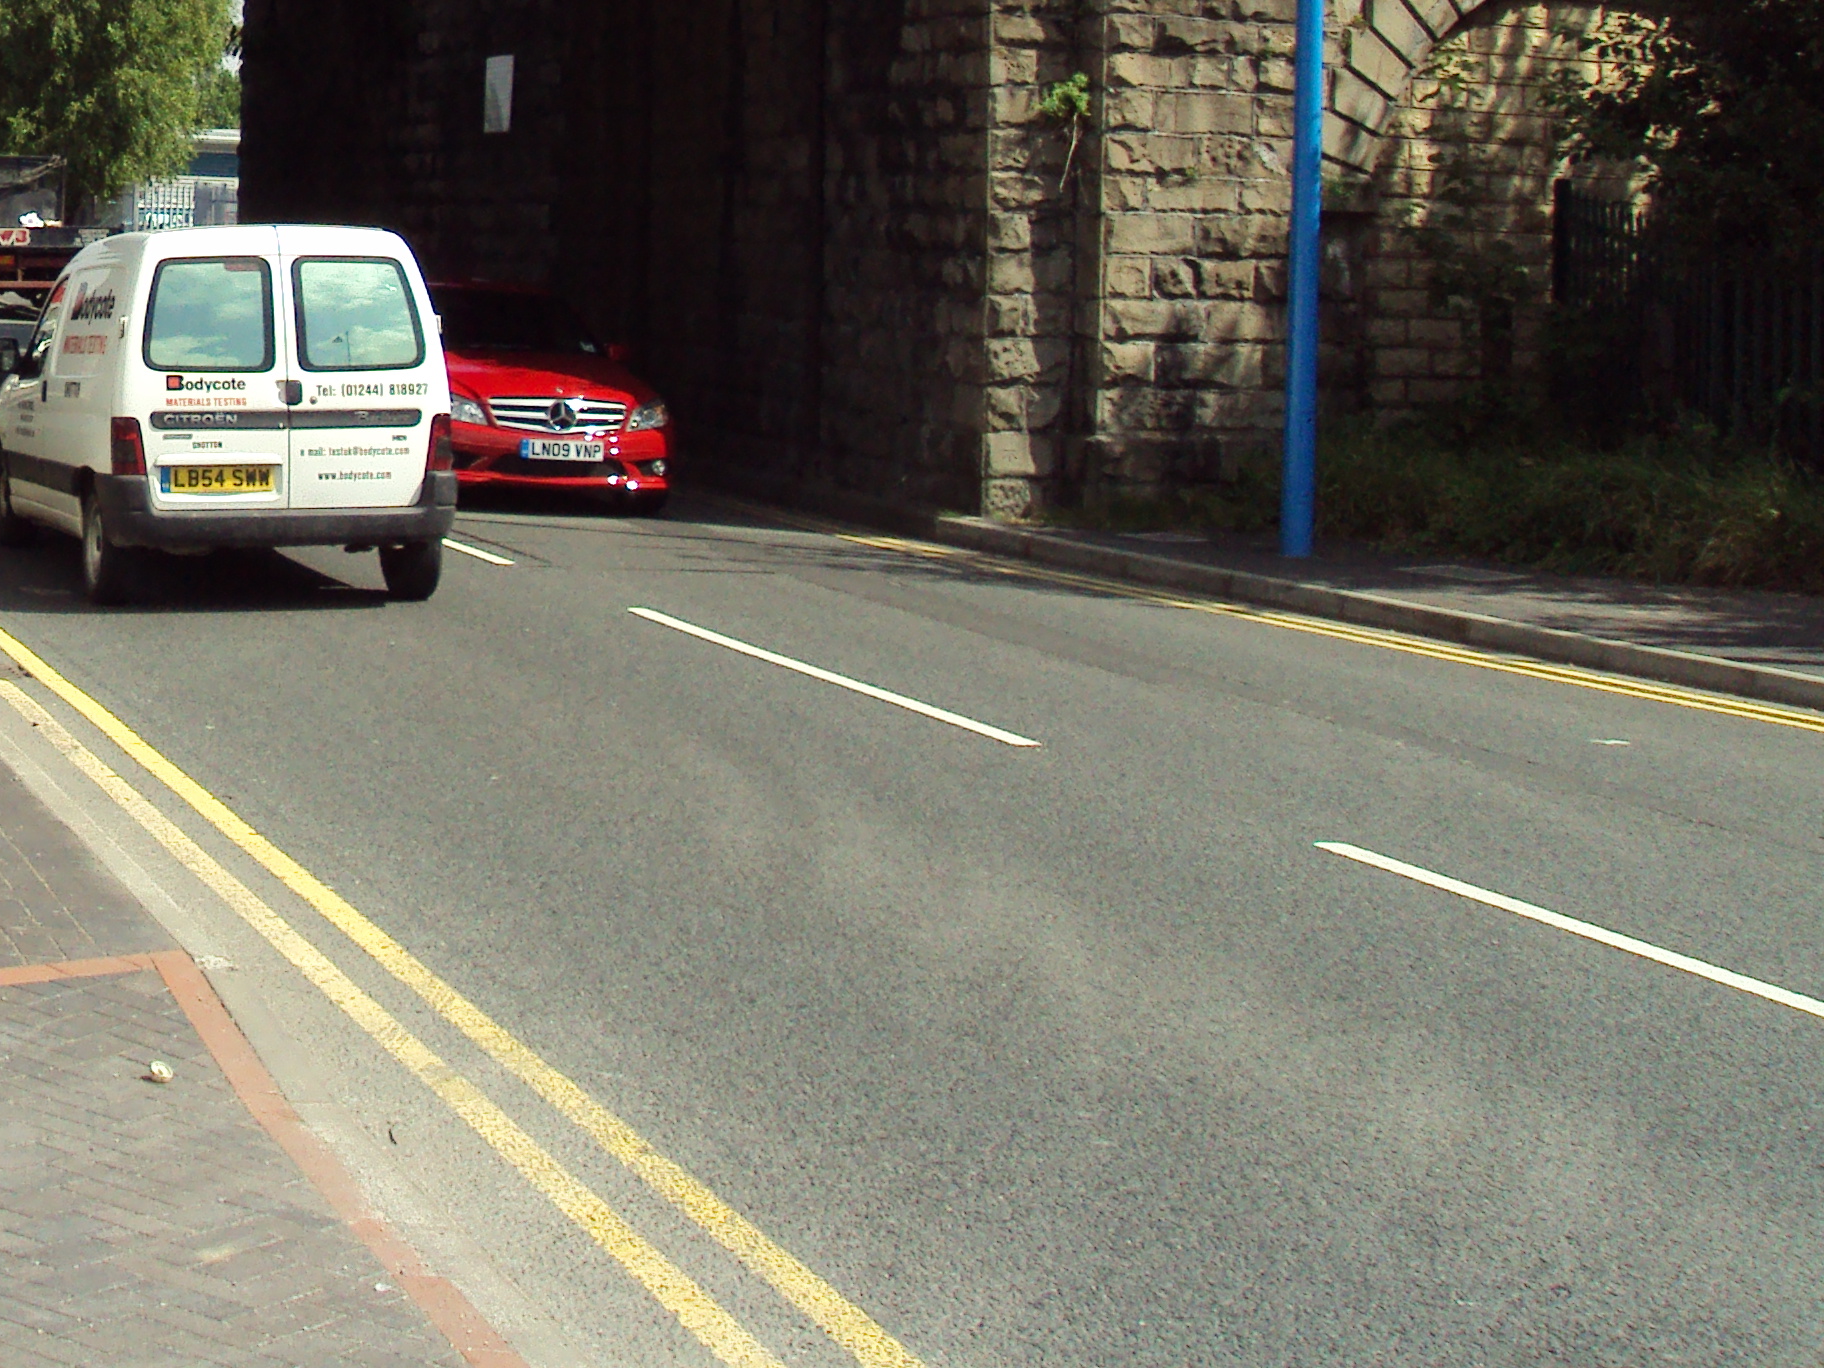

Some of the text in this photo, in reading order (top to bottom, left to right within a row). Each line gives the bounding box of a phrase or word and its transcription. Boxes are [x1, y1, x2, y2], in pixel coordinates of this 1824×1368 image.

[165, 375, 246, 393] Bodycote
[316, 383, 428, 397] Tel: (01244) 818927
[166, 397, 247, 407] MATERIALS TESTING
[163, 412, 237, 425] CITROËN
[531, 442, 601, 458] LN09 VNP
[174, 469, 226, 488] LB54
